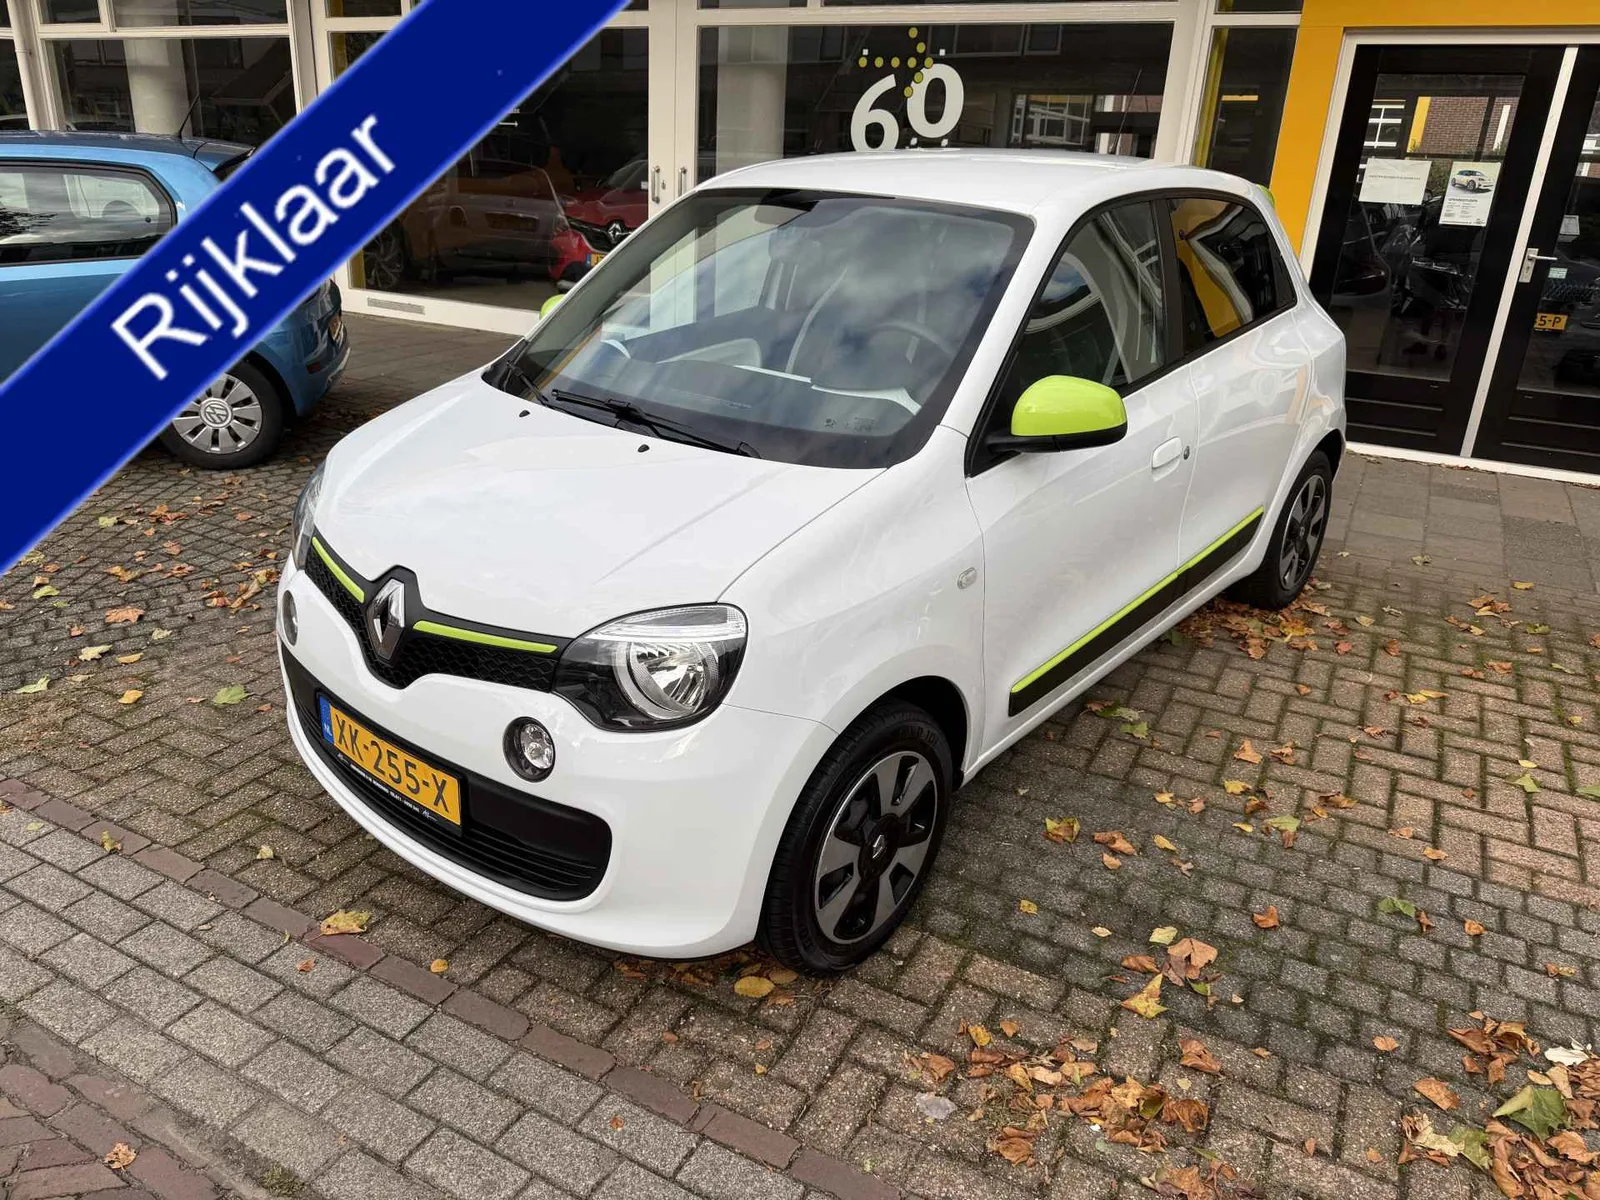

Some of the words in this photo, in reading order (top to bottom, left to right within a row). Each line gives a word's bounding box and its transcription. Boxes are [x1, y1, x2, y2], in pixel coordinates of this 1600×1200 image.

[850, 63, 965, 153] 60
[1536, 315, 1562, 327] 5-P
[335, 714, 450, 814] XK-255-X
